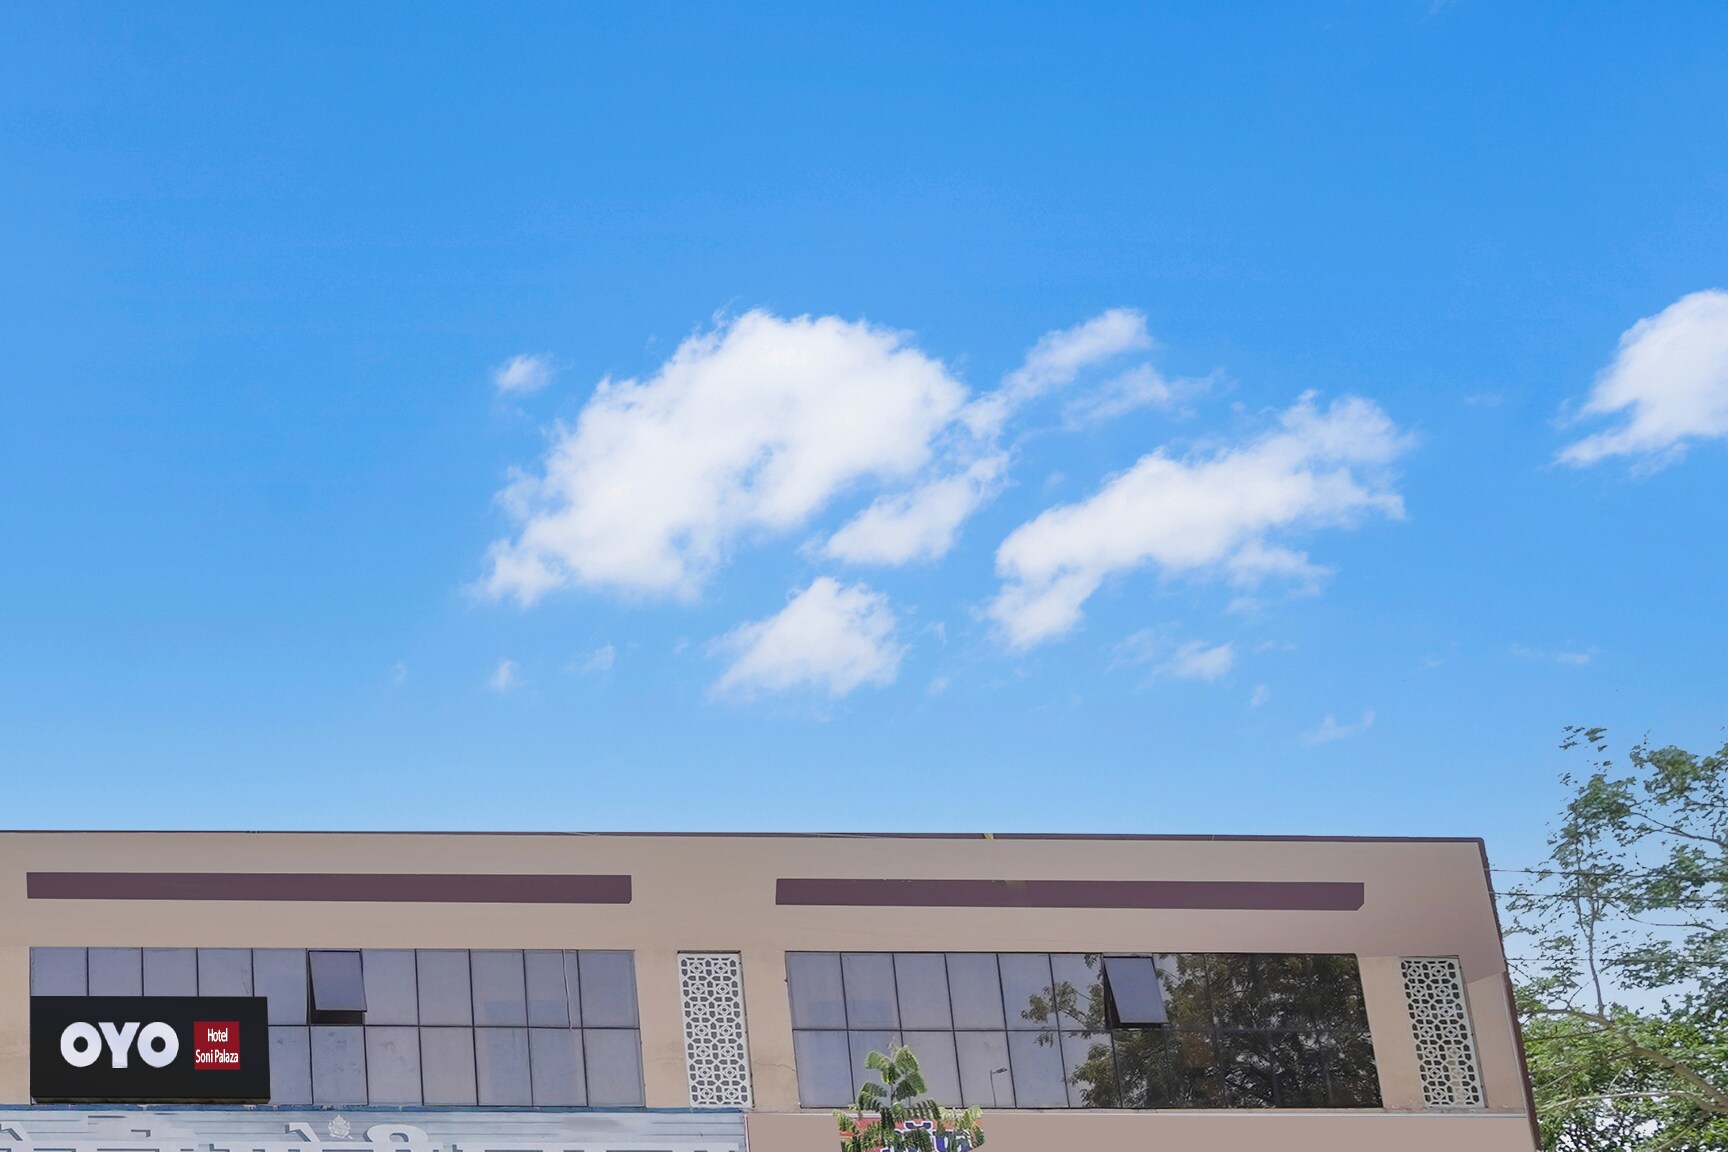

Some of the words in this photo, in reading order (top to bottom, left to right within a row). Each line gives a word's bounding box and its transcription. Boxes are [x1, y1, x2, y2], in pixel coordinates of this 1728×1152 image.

[207, 1028, 228, 1042] Hotel
[60, 1021, 180, 1068] OYO
[195, 1050, 213, 1063] Soni
[214, 1050, 239, 1063] Palaza
